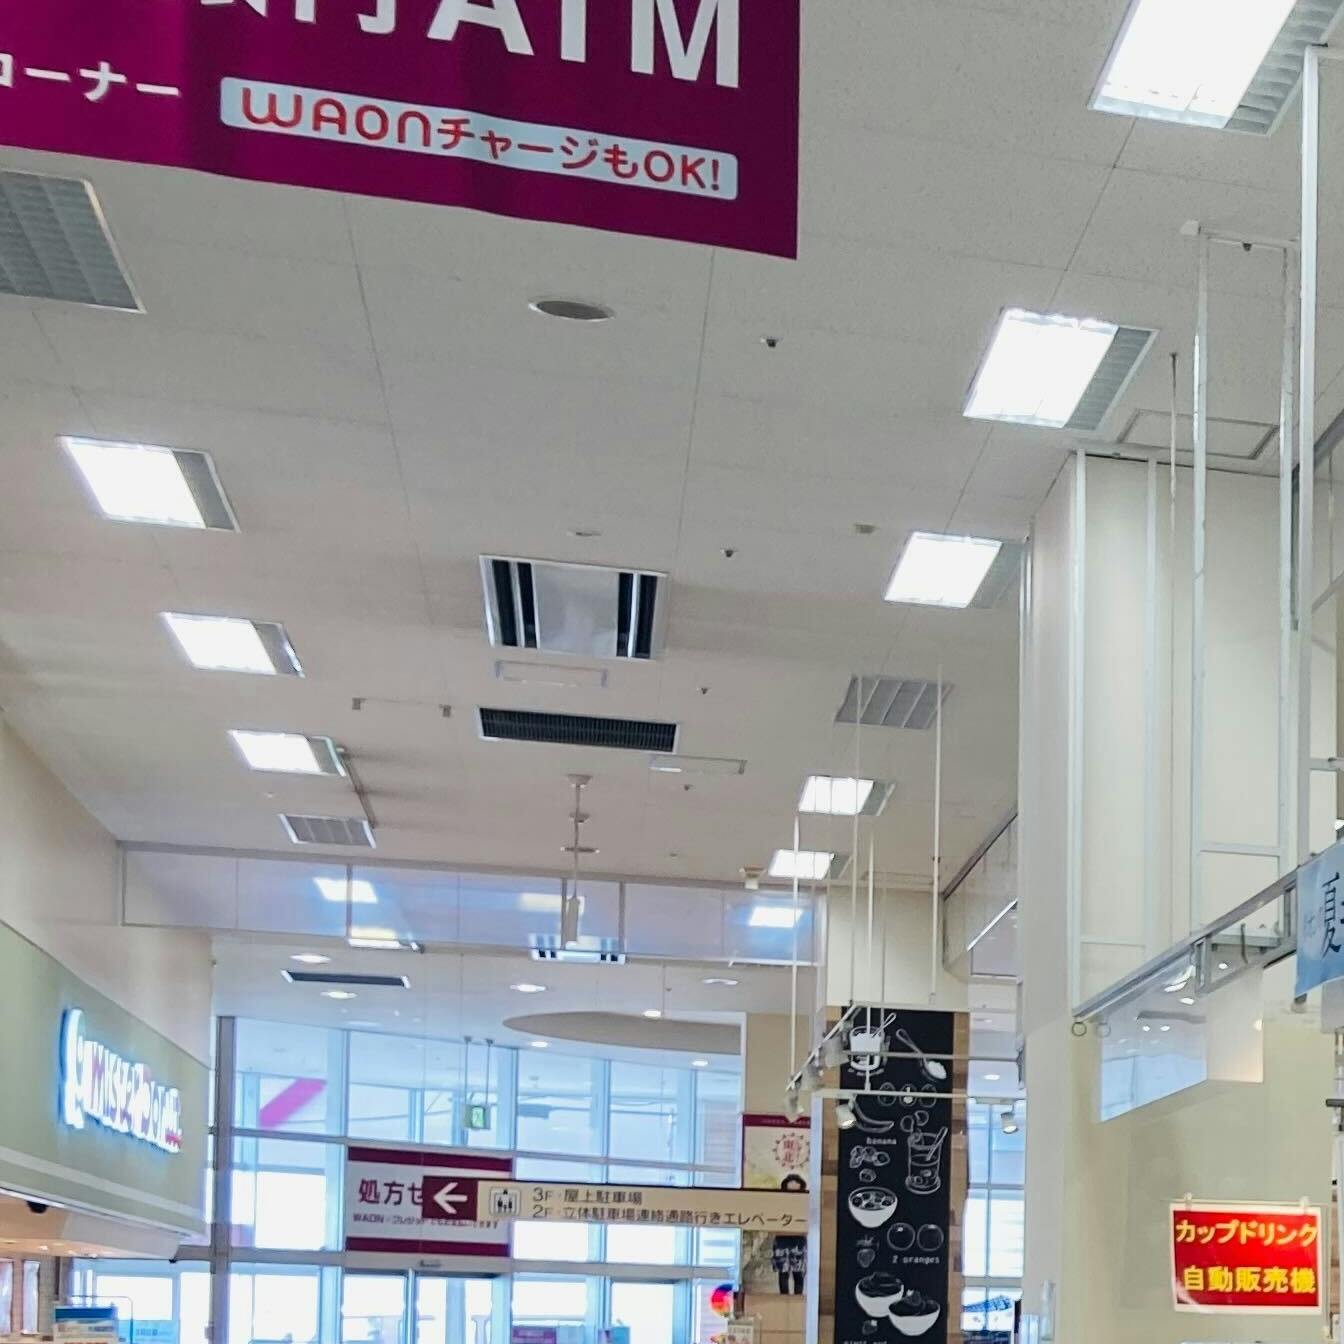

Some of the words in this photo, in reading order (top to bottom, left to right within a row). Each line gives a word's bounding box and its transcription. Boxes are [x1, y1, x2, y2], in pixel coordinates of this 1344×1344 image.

[1174, 1220, 1319, 1246] カップドリンク
[1184, 1266, 1317, 1294] 自動販売機
